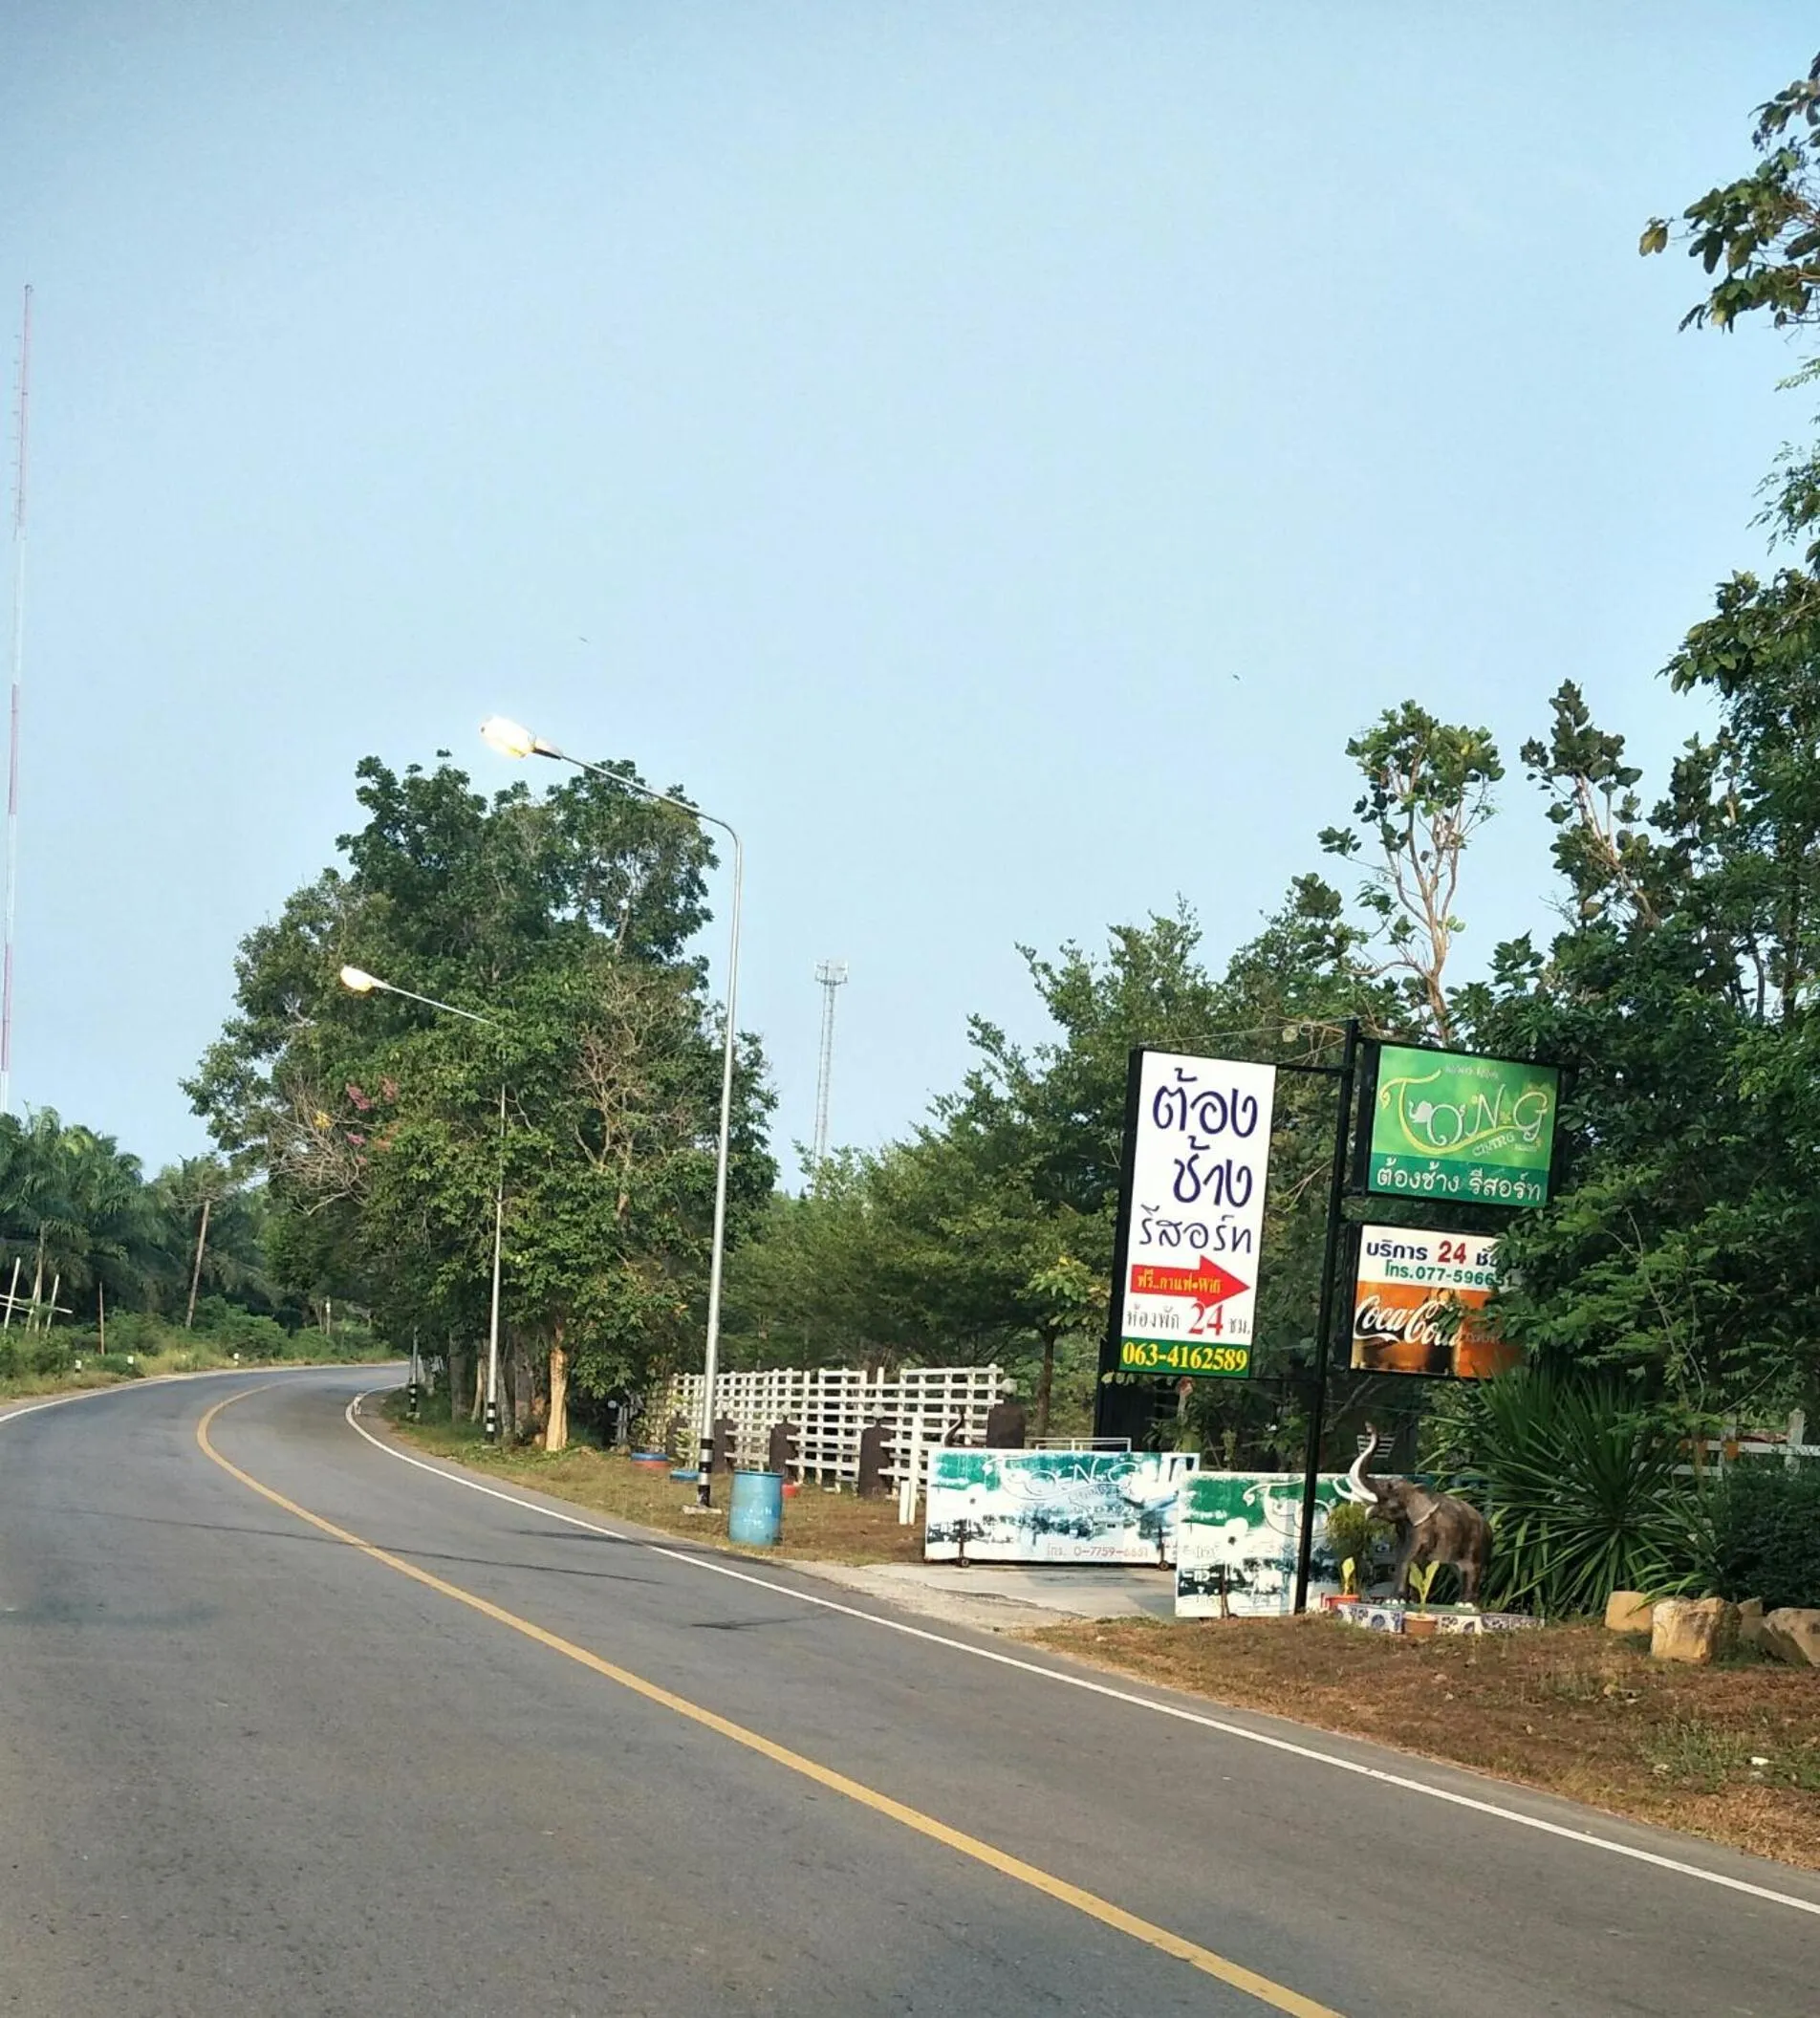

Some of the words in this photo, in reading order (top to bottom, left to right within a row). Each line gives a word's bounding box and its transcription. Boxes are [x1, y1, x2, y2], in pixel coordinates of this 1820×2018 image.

[1153, 1067, 1258, 1138] ต้อง
[1173, 1135, 1252, 1207] ช้าง
[1376, 1157, 1459, 1193] ต้องช้าง
[1468, 1167, 1541, 1201] รีสอร์ท
[1366, 1239, 1428, 1260] บริการ
[1438, 1240, 1466, 1265] 24
[1127, 1303, 1181, 1330] ห้องพัก
[1188, 1301, 1224, 1335] 24
[1122, 1341, 1248, 1372] 063-4162589
